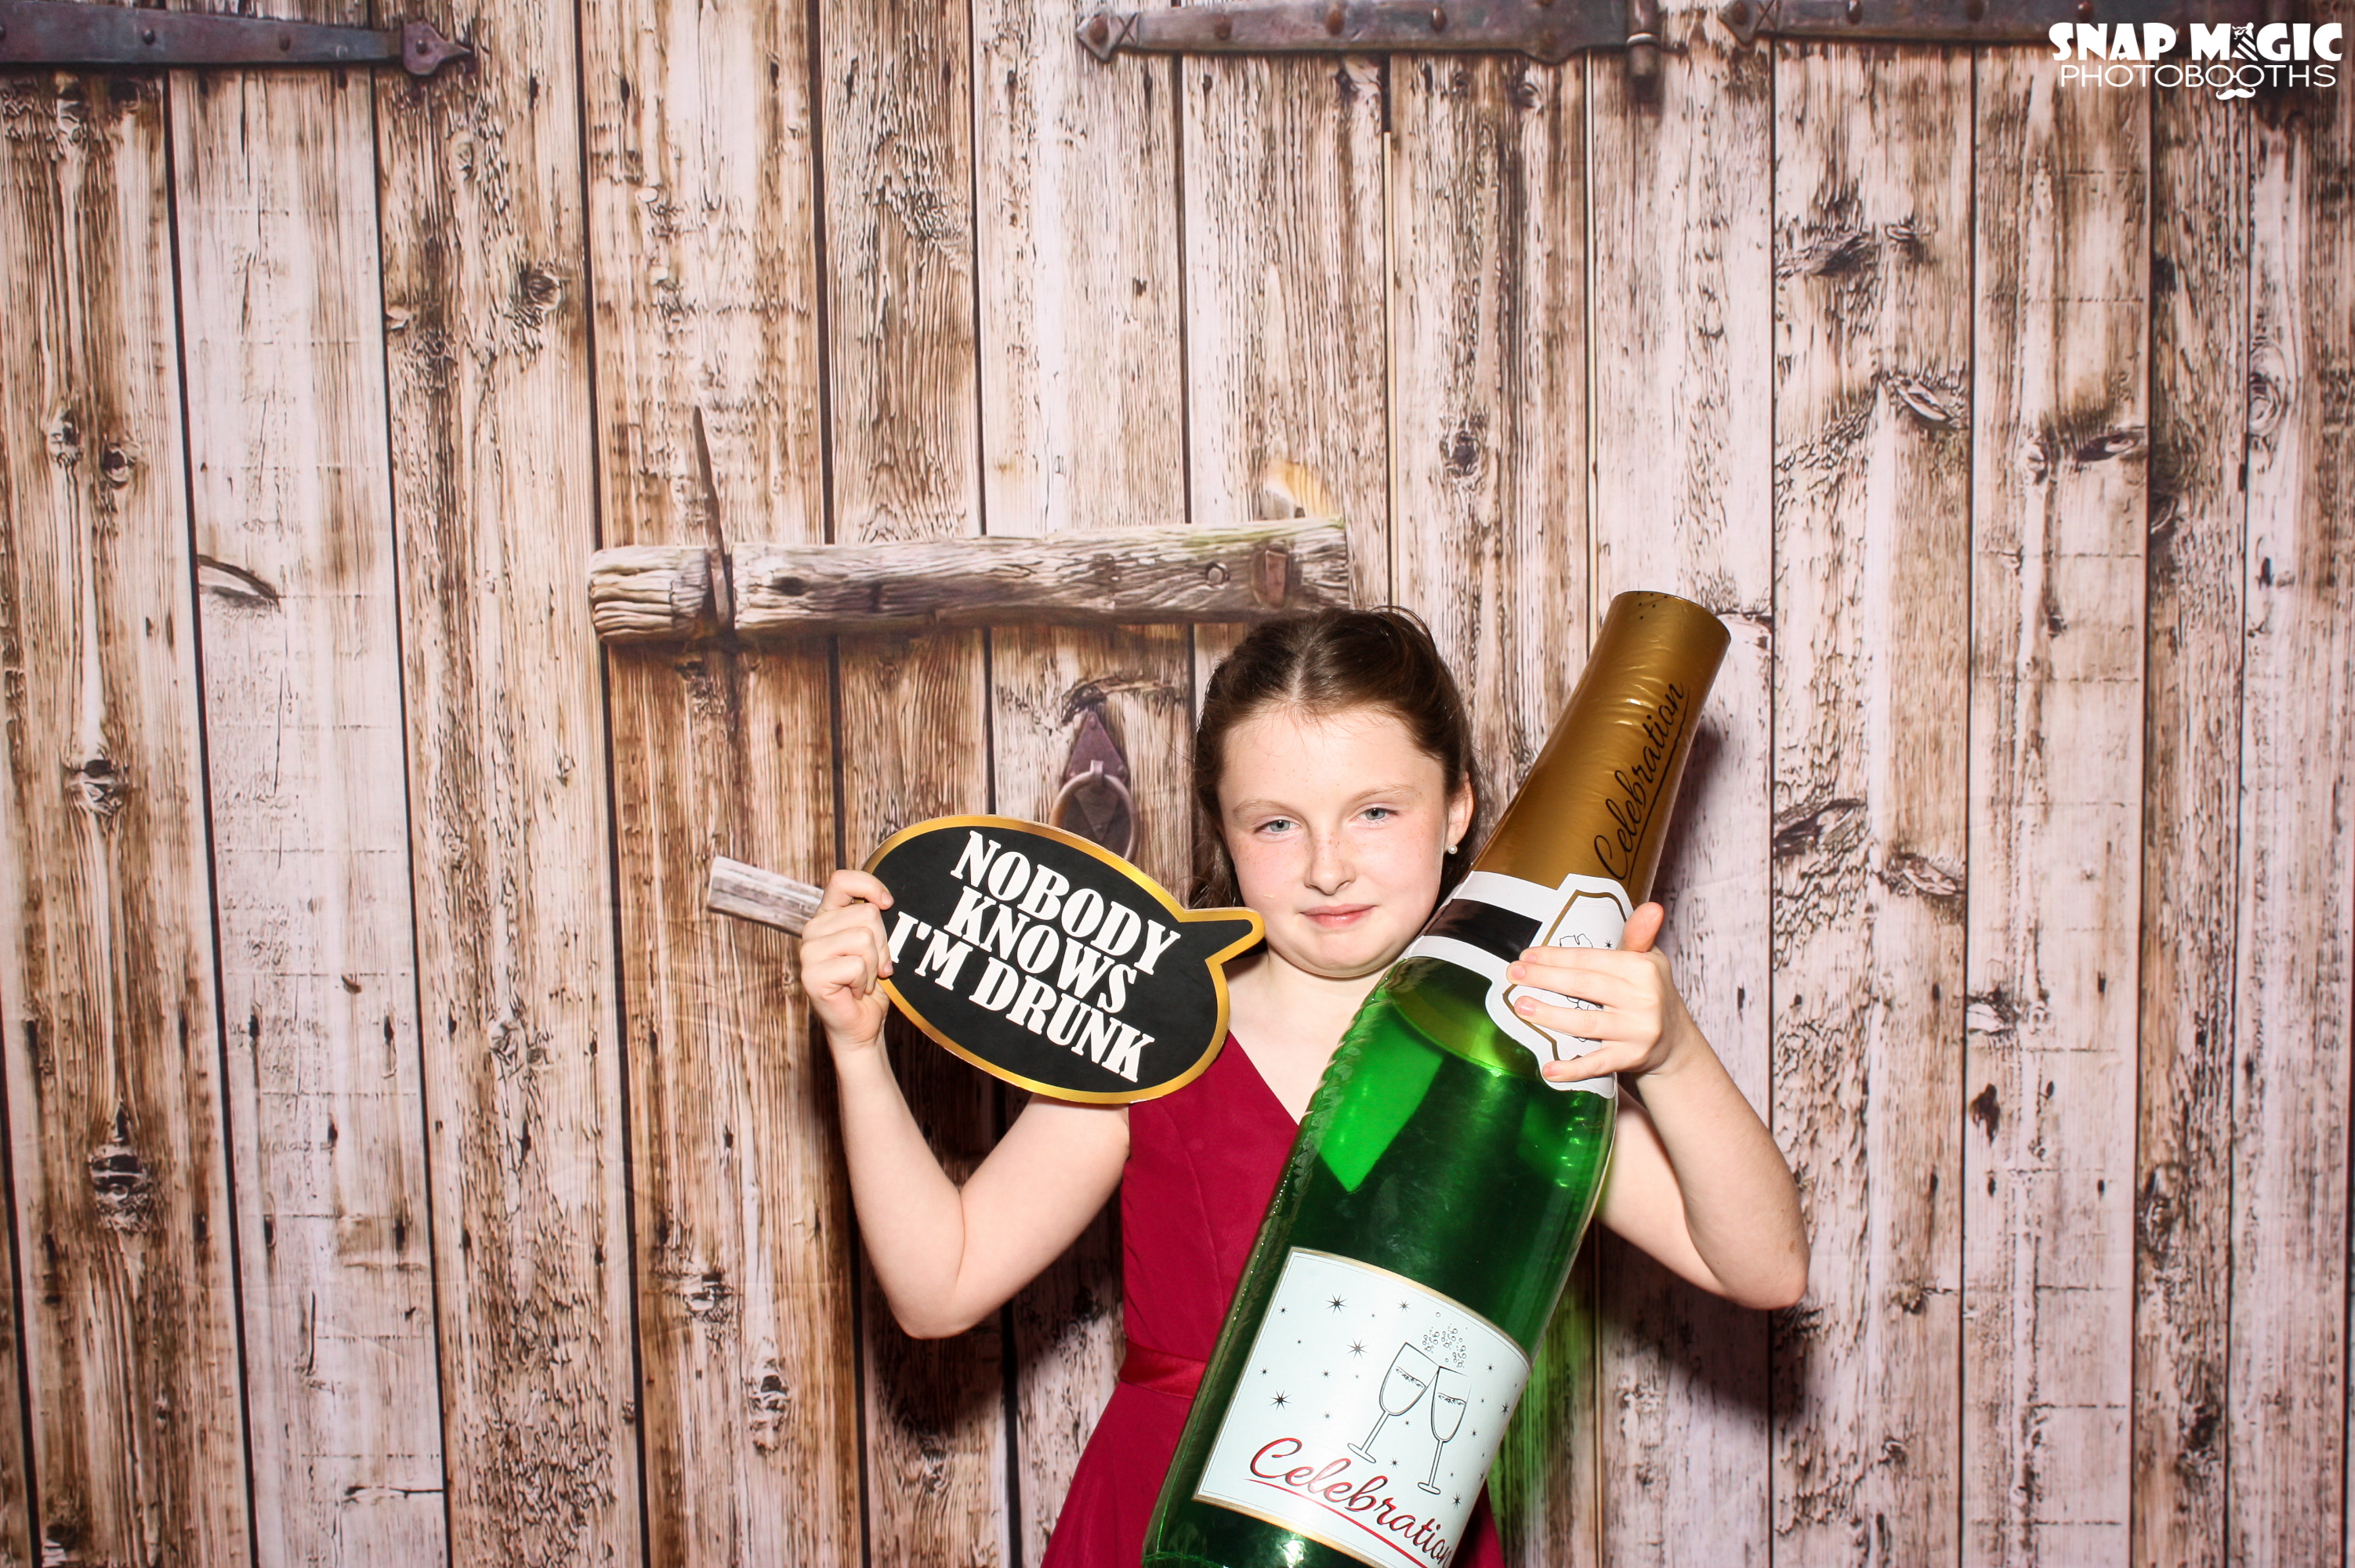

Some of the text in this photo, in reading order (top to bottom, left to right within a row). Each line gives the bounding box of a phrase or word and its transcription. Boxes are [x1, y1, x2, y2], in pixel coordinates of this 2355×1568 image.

[1593, 681, 1685, 881] Celebration
[944, 885, 1136, 1013] KNOWS
[950, 831, 1181, 976] NOBODY
[887, 911, 1155, 1083] I'M DRUNK
